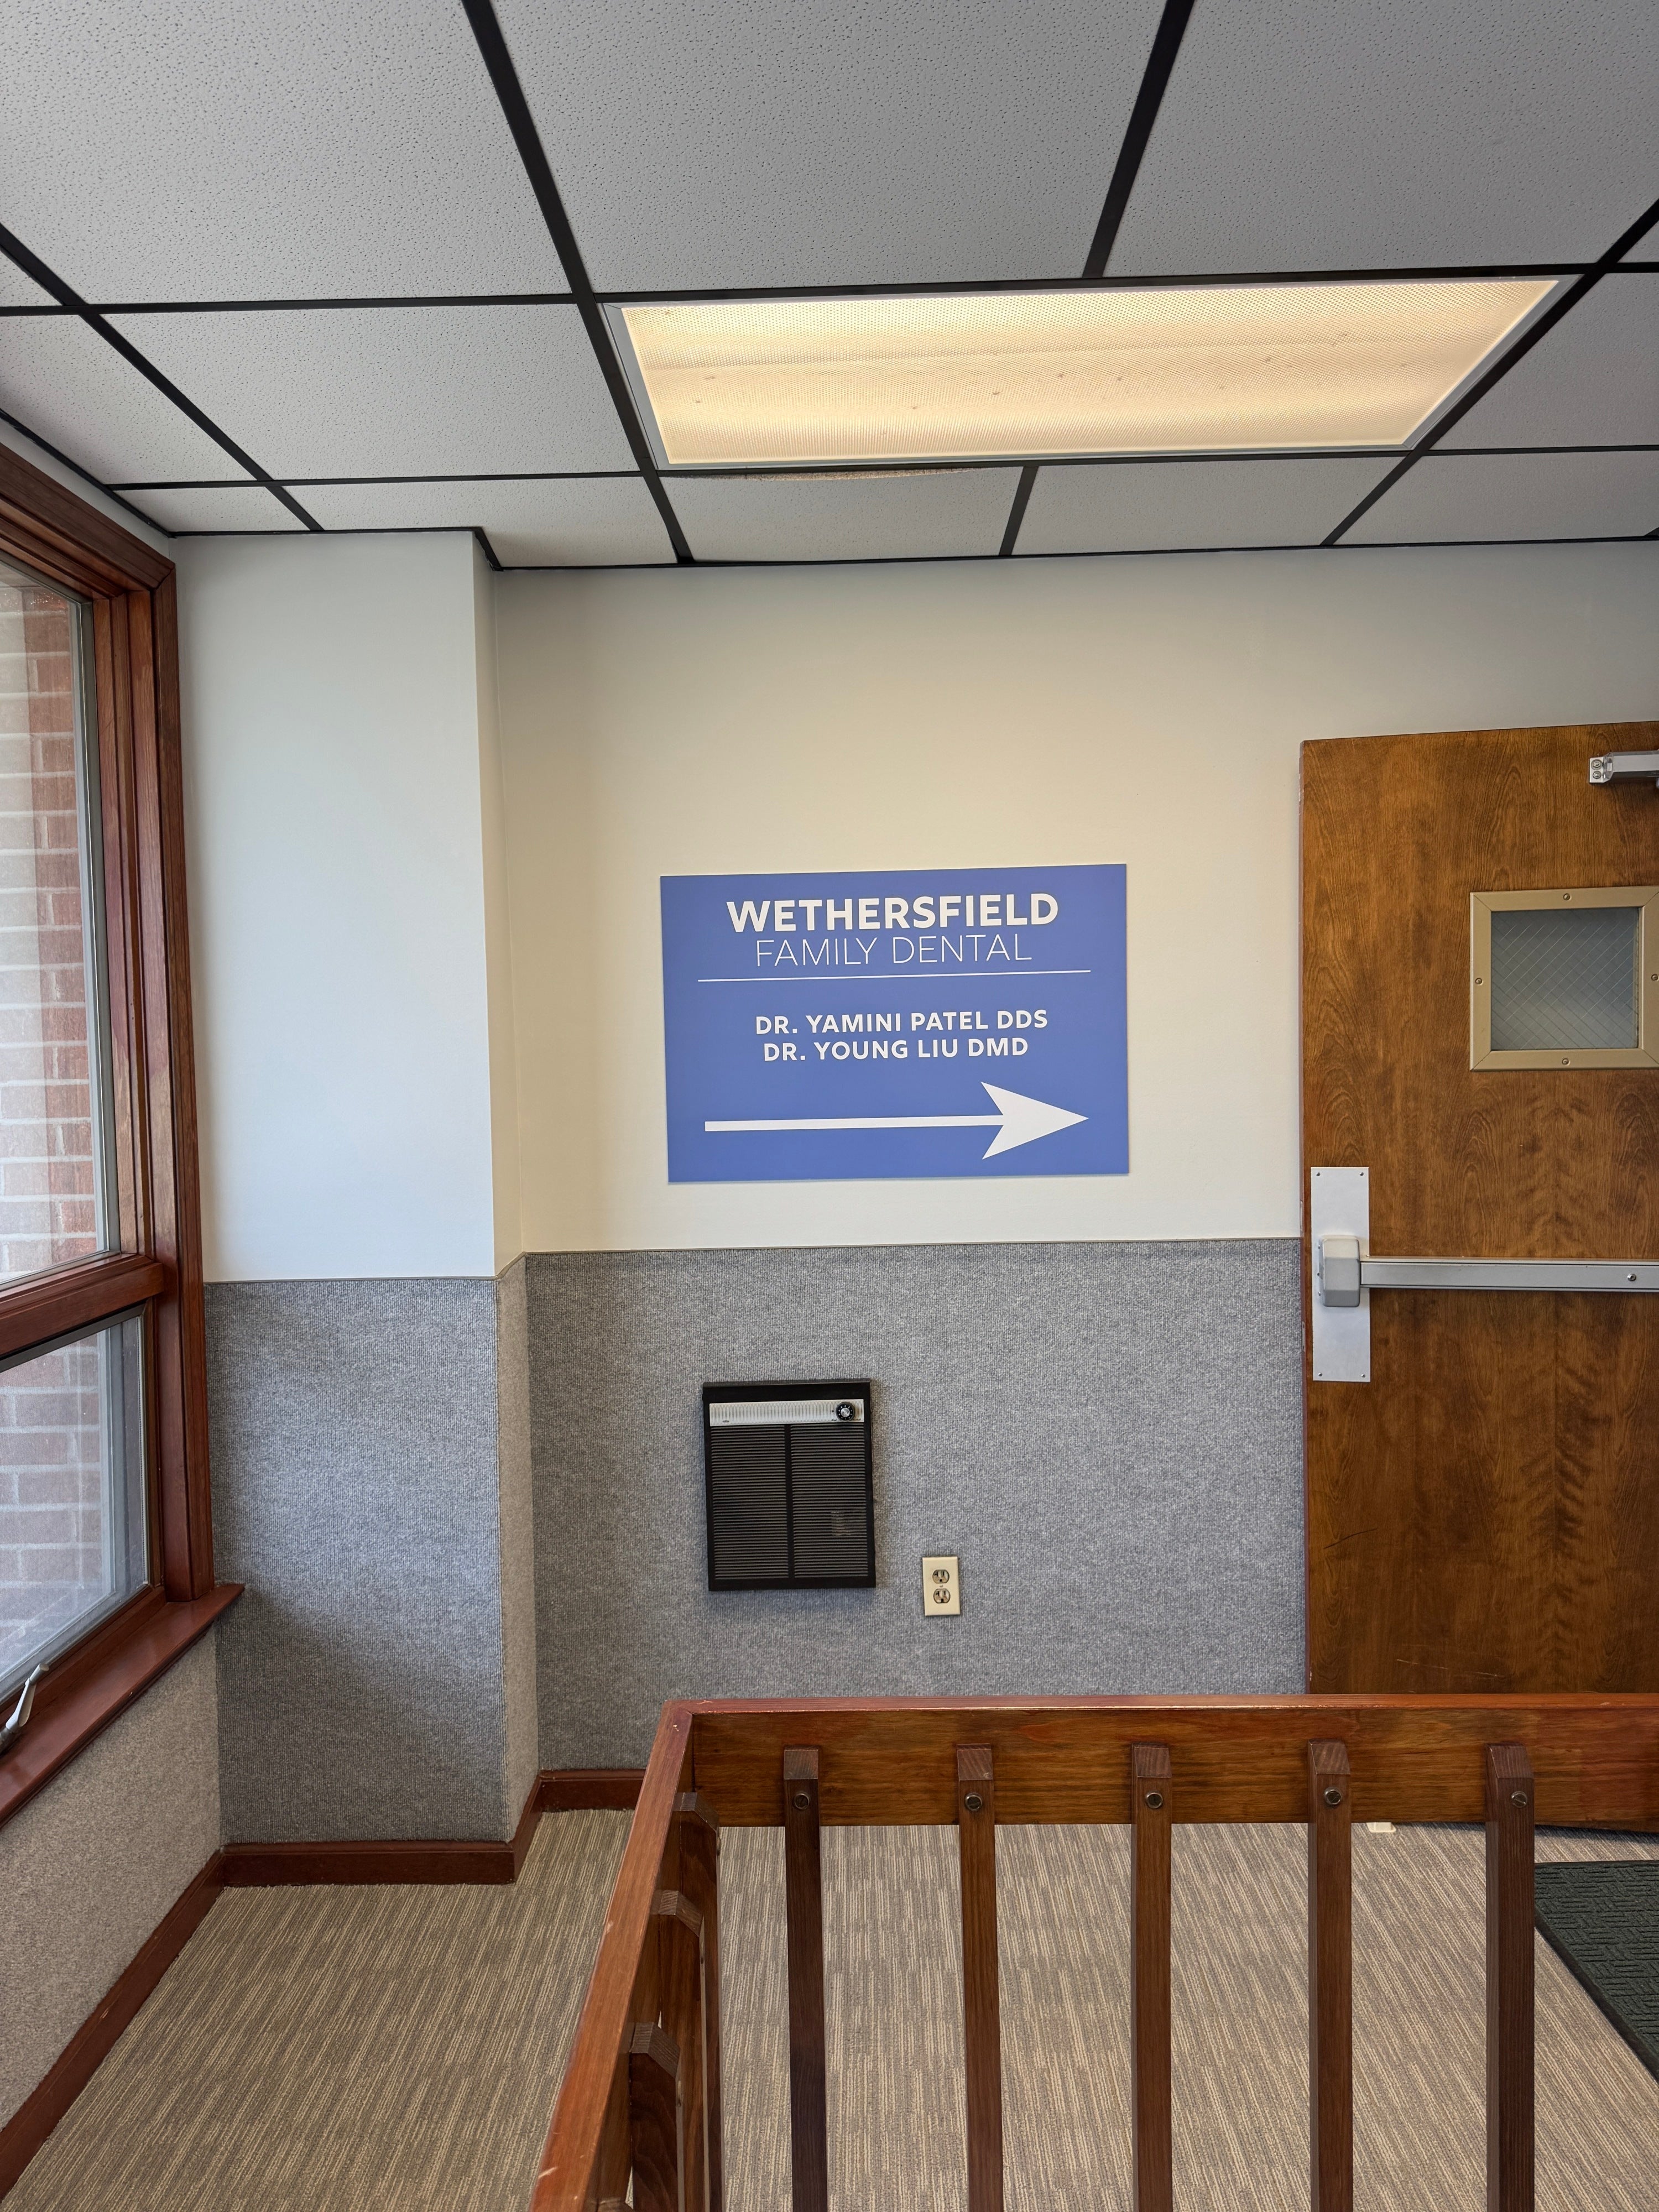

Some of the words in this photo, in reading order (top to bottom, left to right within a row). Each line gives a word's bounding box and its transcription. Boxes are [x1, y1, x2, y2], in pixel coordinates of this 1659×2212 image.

[726, 893, 1058, 932] WETHERSFIELD
[757, 937, 878, 967] FAMILY
[893, 933, 1032, 964] DENTAL
[756, 1015, 797, 1035] DR.
[805, 1013, 901, 1034] YAMINI
[911, 1011, 989, 1031] PATEL
[997, 1009, 1048, 1029] DDS
[764, 1042, 806, 1061] DR.
[813, 1040, 908, 1060] YOUNG
[918, 1039, 958, 1058] LIU
[968, 1037, 1028, 1057] DMD
